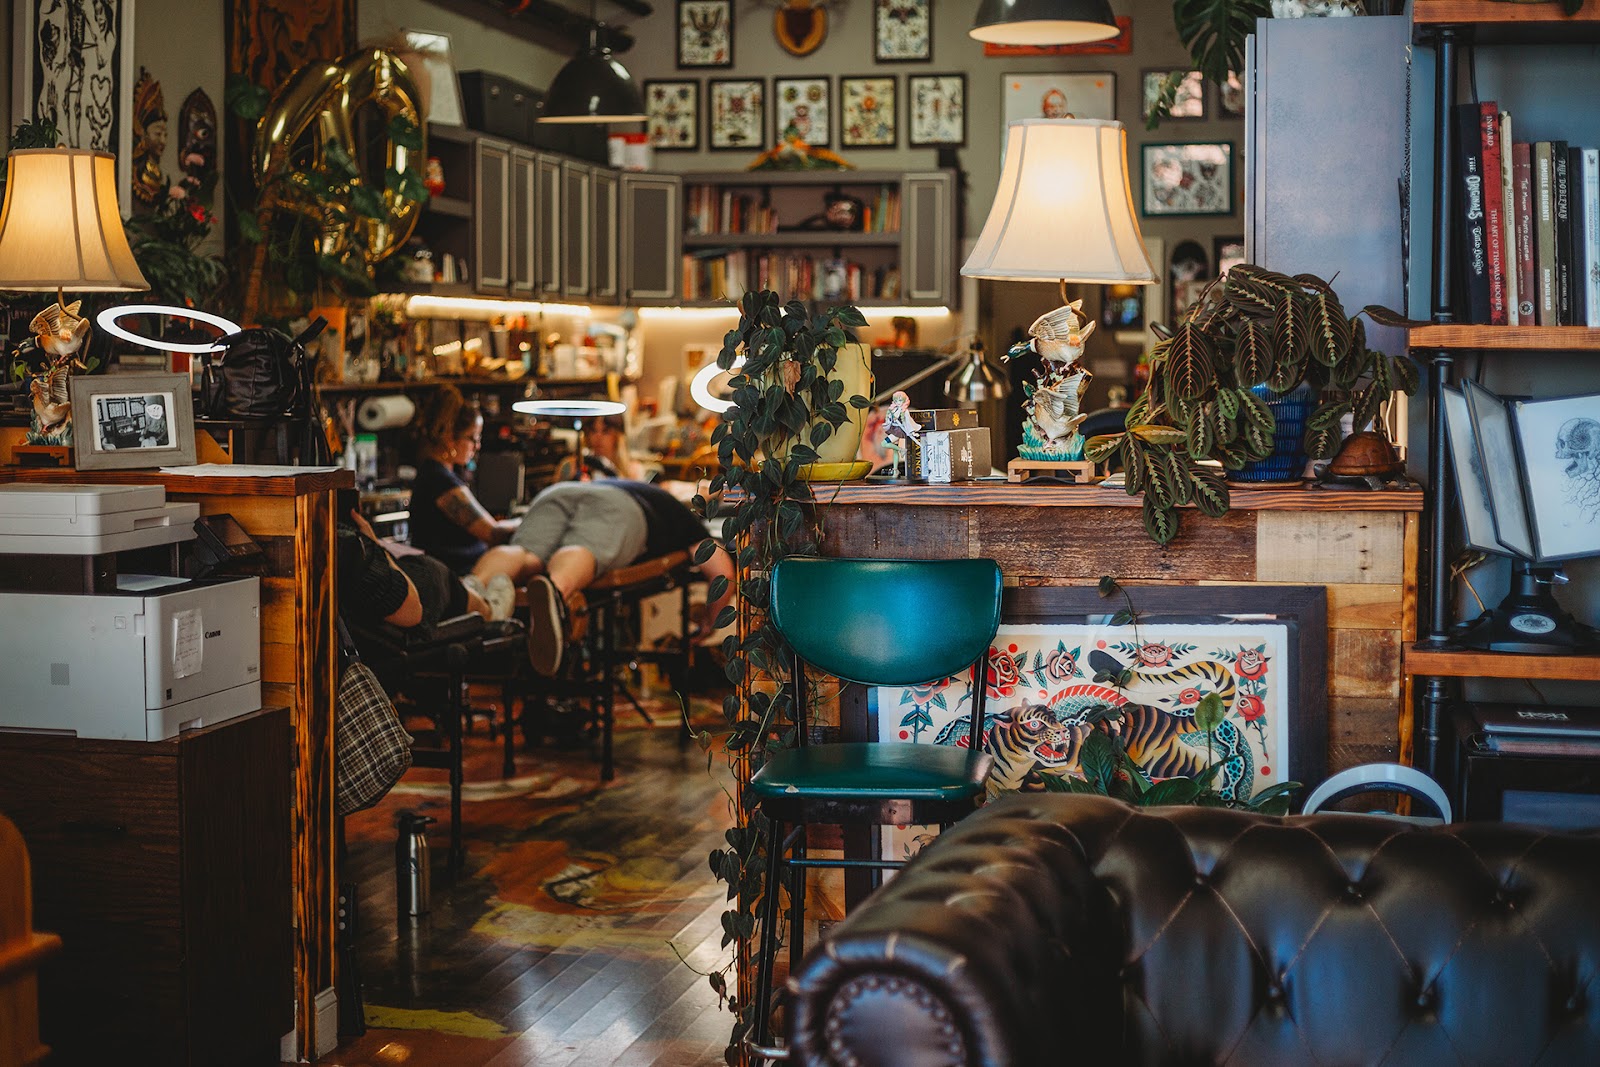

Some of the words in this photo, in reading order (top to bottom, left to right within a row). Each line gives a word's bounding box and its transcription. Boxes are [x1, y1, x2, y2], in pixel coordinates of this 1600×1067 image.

[1558, 159, 1566, 176] PAUL
[1466, 176, 1482, 219] ORIGINALS
[1558, 178, 1567, 219] DOBLEMAN
[1492, 239, 1499, 250] OF
[204, 630, 221, 639] Canon
